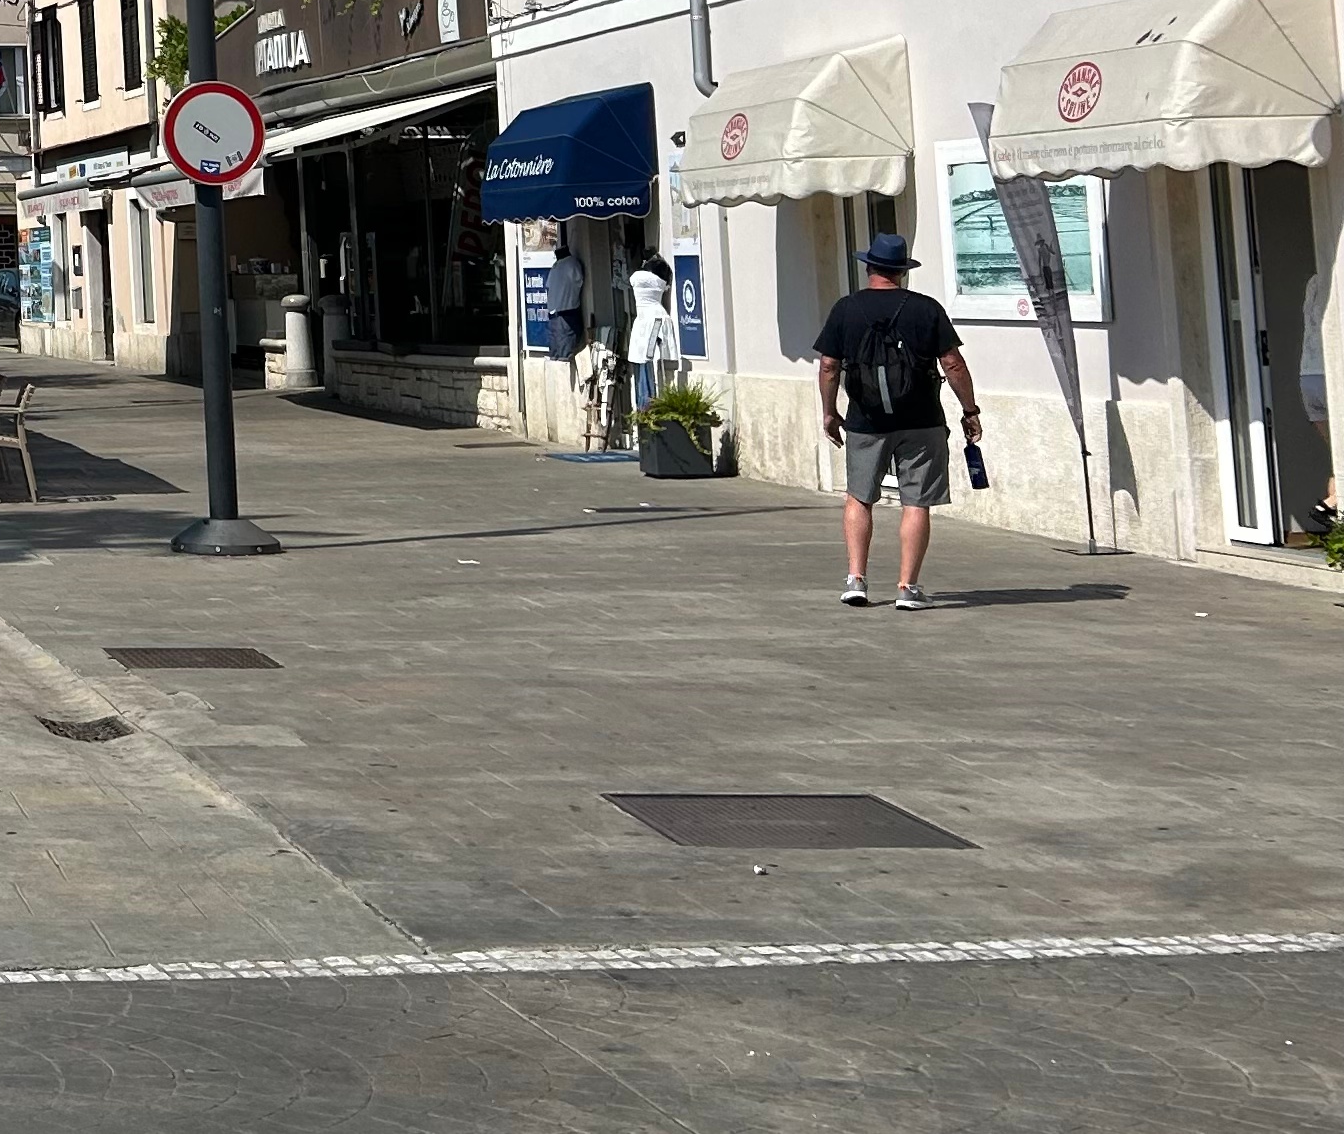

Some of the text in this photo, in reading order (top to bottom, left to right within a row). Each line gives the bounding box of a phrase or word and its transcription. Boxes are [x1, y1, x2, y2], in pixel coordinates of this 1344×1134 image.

[486, 159, 500, 181] La
[574, 196, 640, 208] 100% coton
